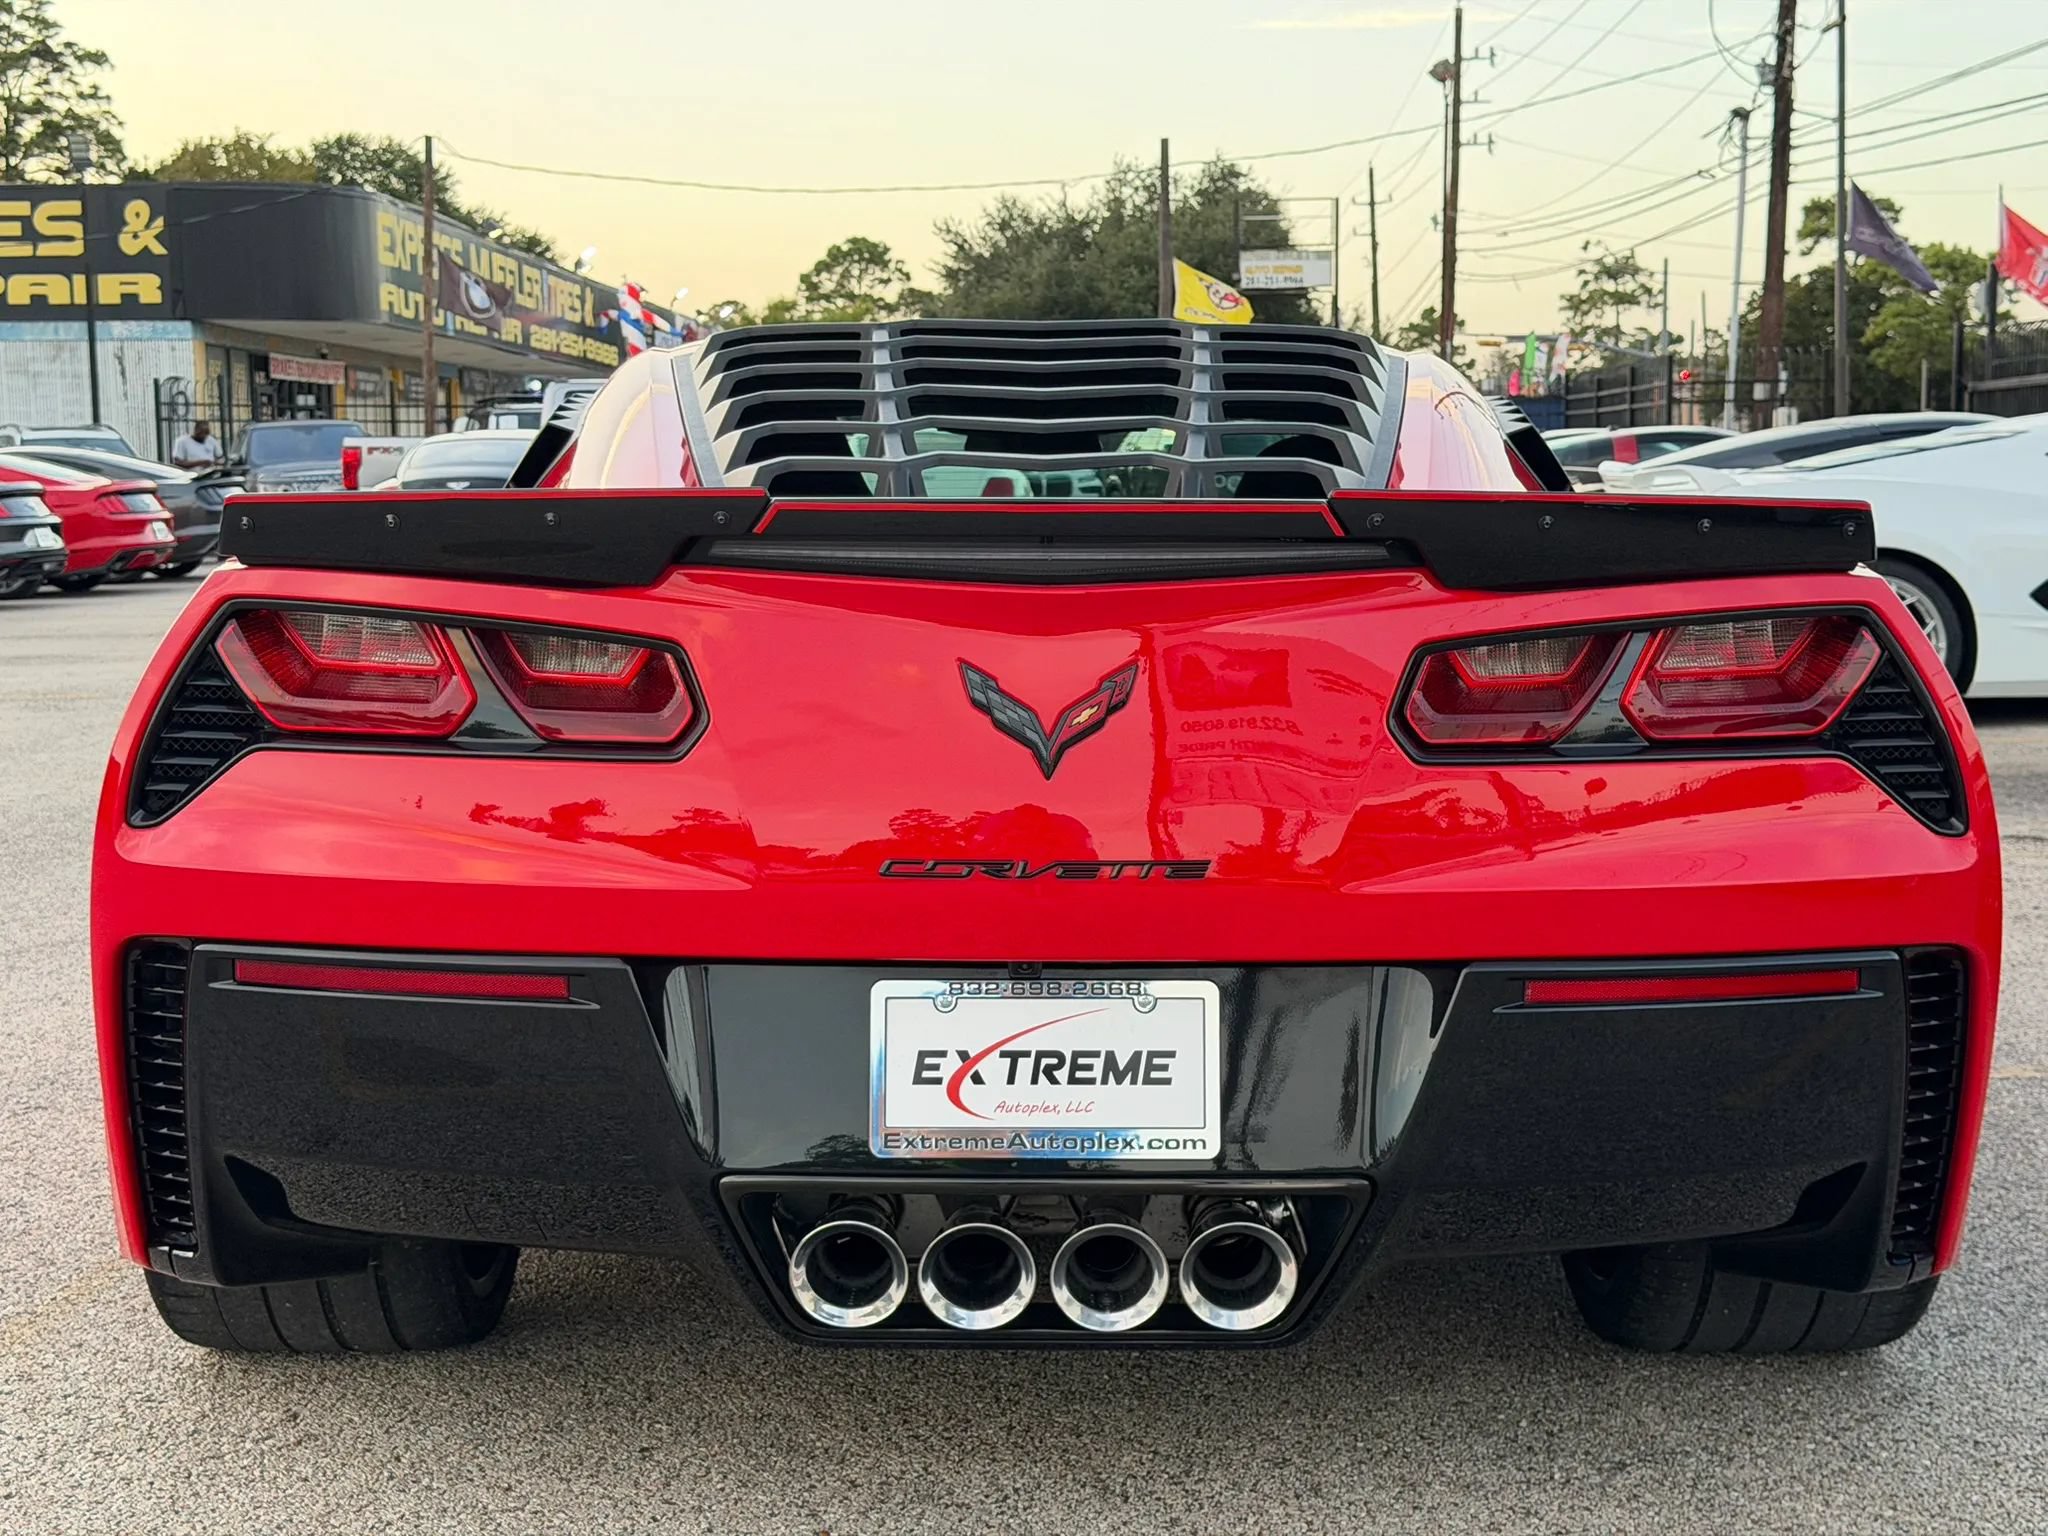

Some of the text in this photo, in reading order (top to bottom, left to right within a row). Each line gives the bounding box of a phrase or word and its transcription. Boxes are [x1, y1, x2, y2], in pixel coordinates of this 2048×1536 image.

[118, 199, 168, 256] &
[0, 273, 162, 305] AIR
[879, 859, 1211, 880] CORVETTE
[911, 1049, 1177, 1087] EXTREME
[994, 1100, 1095, 1117] Autoplex, LLC
[883, 1132, 1207, 1153] ExtremeAutoplex.com
